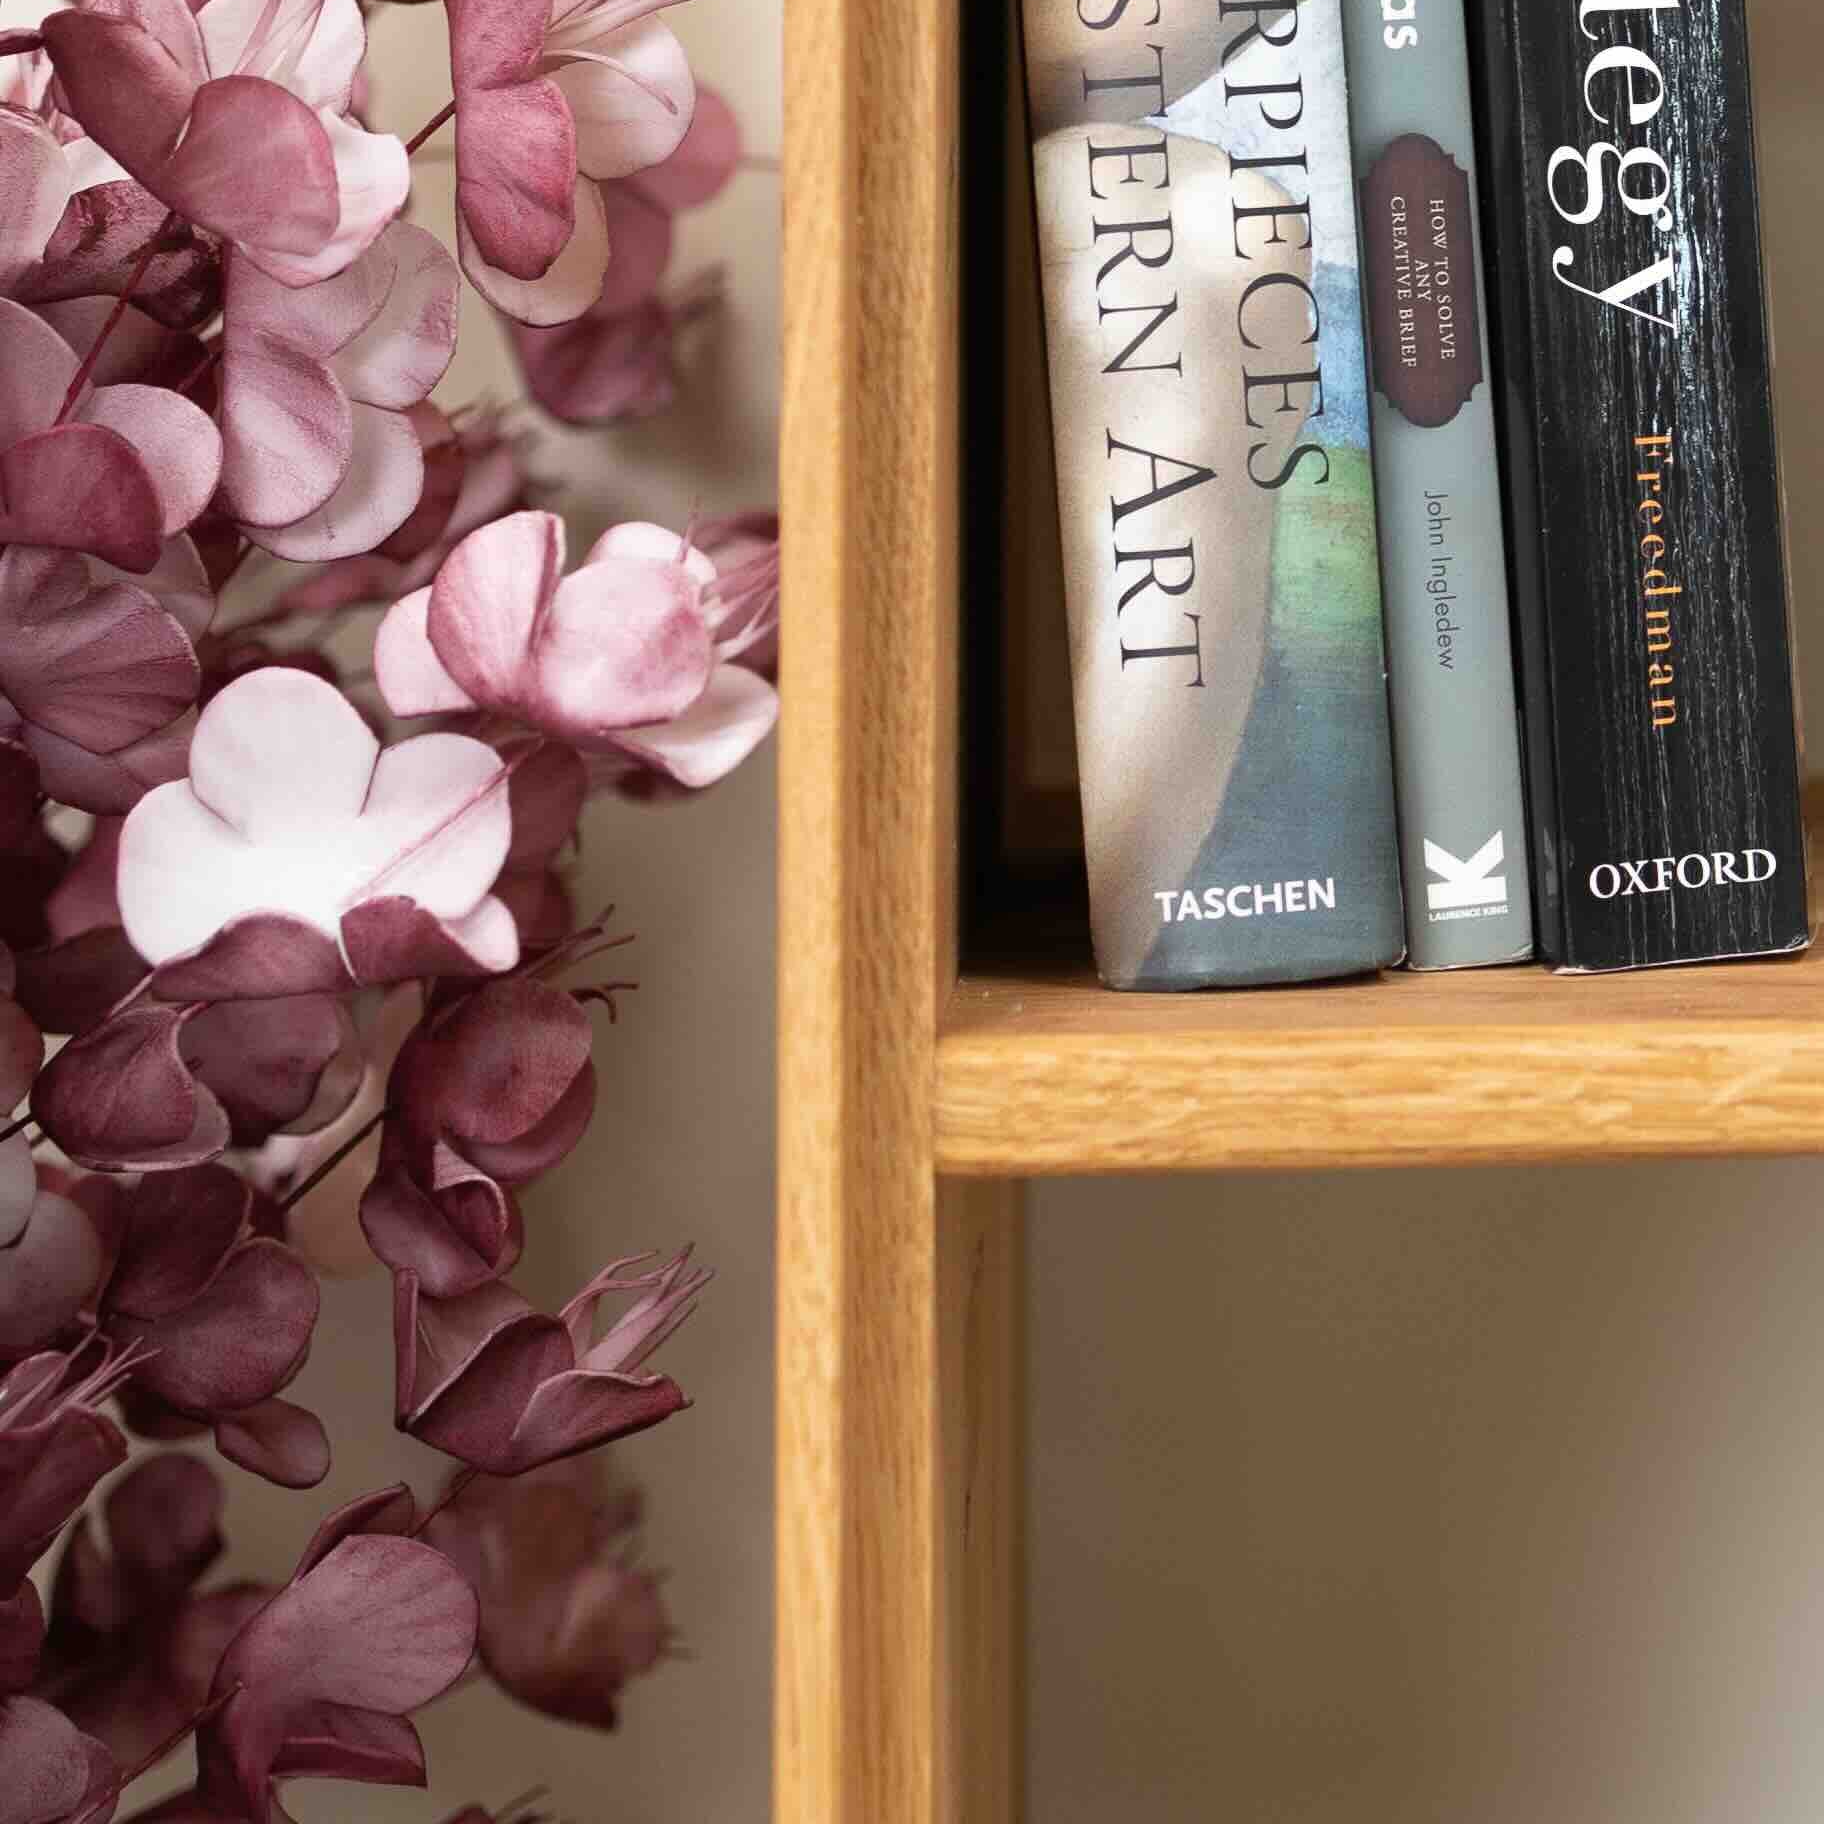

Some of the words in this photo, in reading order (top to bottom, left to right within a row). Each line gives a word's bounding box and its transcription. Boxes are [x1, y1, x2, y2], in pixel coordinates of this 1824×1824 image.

[1390, 196, 1413, 300] CREATIVE
[1429, 199, 1447, 249] HOW
[1414, 258, 1432, 302] ANY
[1434, 256, 1450, 285] TO
[1399, 309, 1416, 367] BRIEF
[1436, 294, 1456, 360] SOLVE
[1424, 491, 1451, 545] John
[1105, 427, 1217, 688] ART
[1634, 435, 1682, 726] Freedman
[1426, 557, 1460, 670] Ingledew
[1154, 877, 1336, 922] TASCHEN
[1589, 849, 1777, 899] OXFORD
